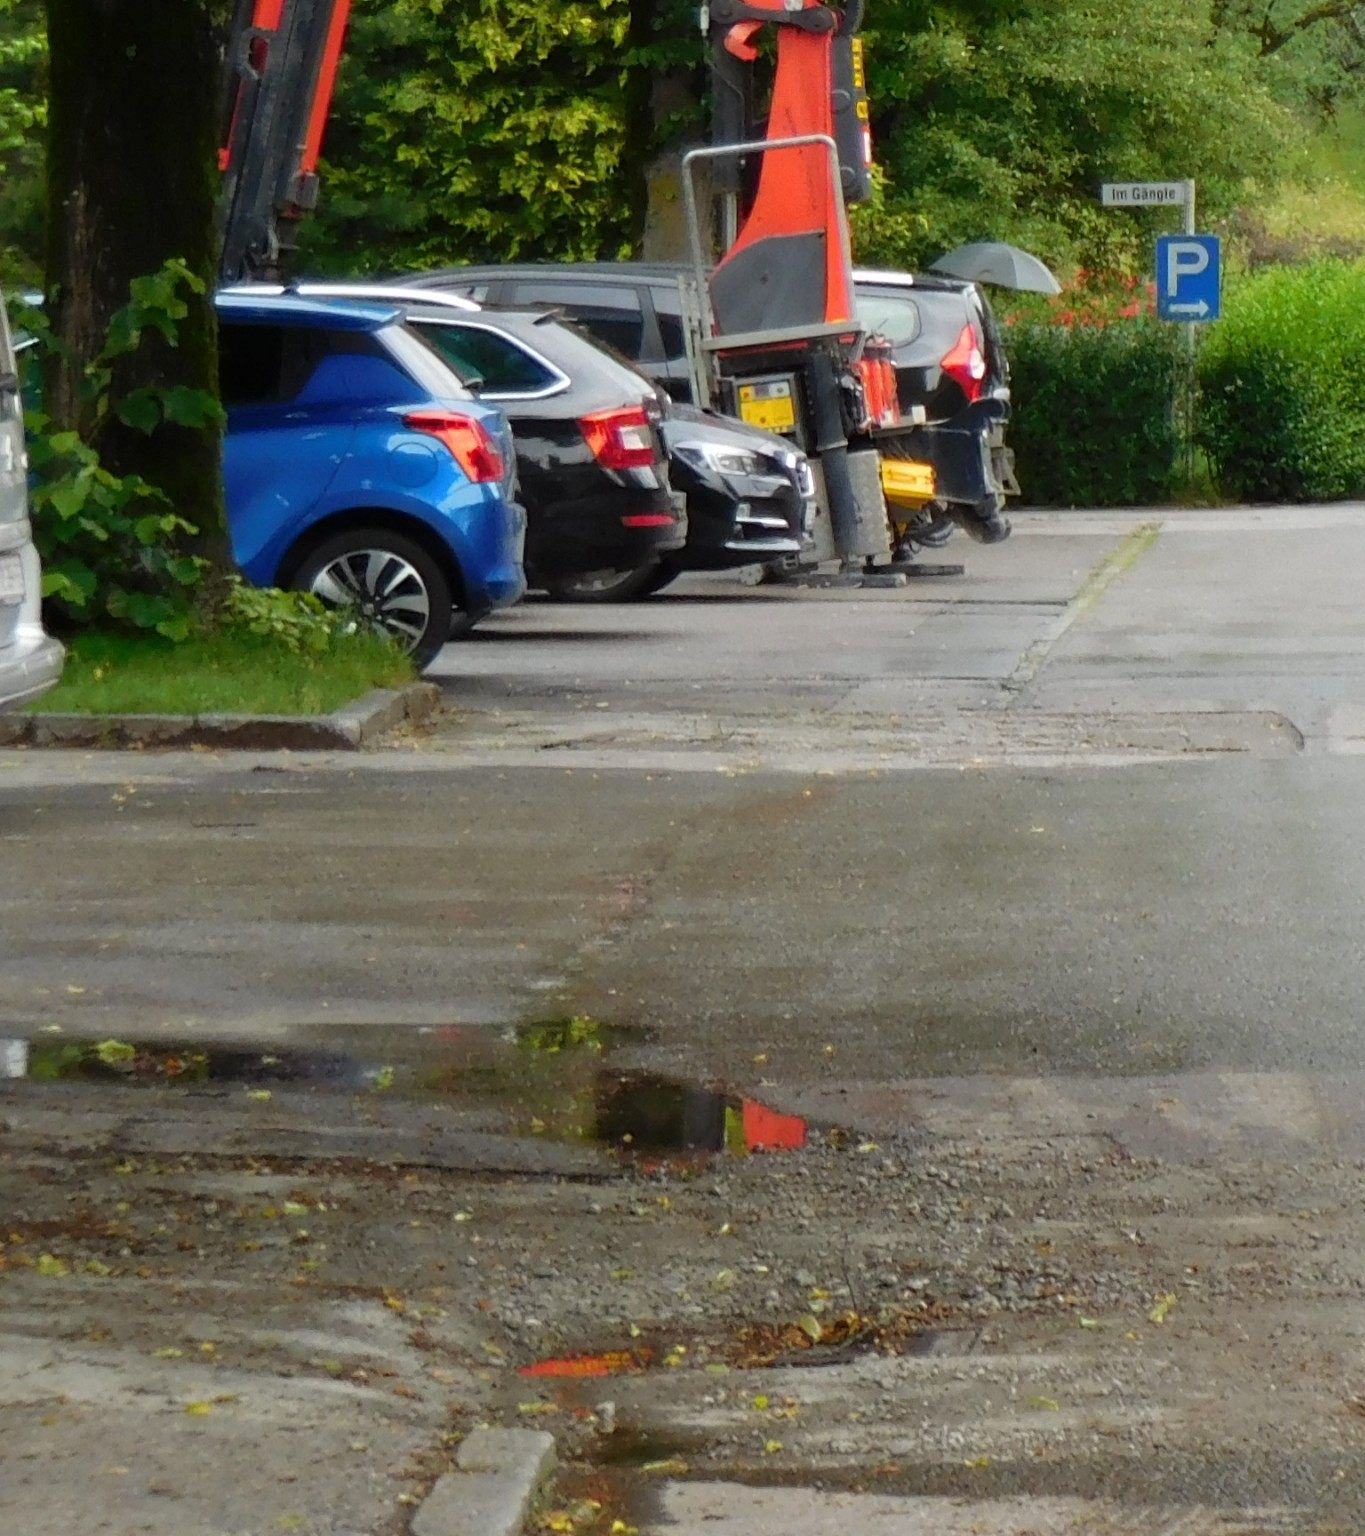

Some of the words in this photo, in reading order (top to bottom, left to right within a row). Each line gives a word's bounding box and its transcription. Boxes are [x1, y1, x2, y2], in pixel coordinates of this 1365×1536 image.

[1112, 188, 1127, 201] Im
[1132, 187, 1176, 203] Gängle
[1167, 242, 1210, 297] P
